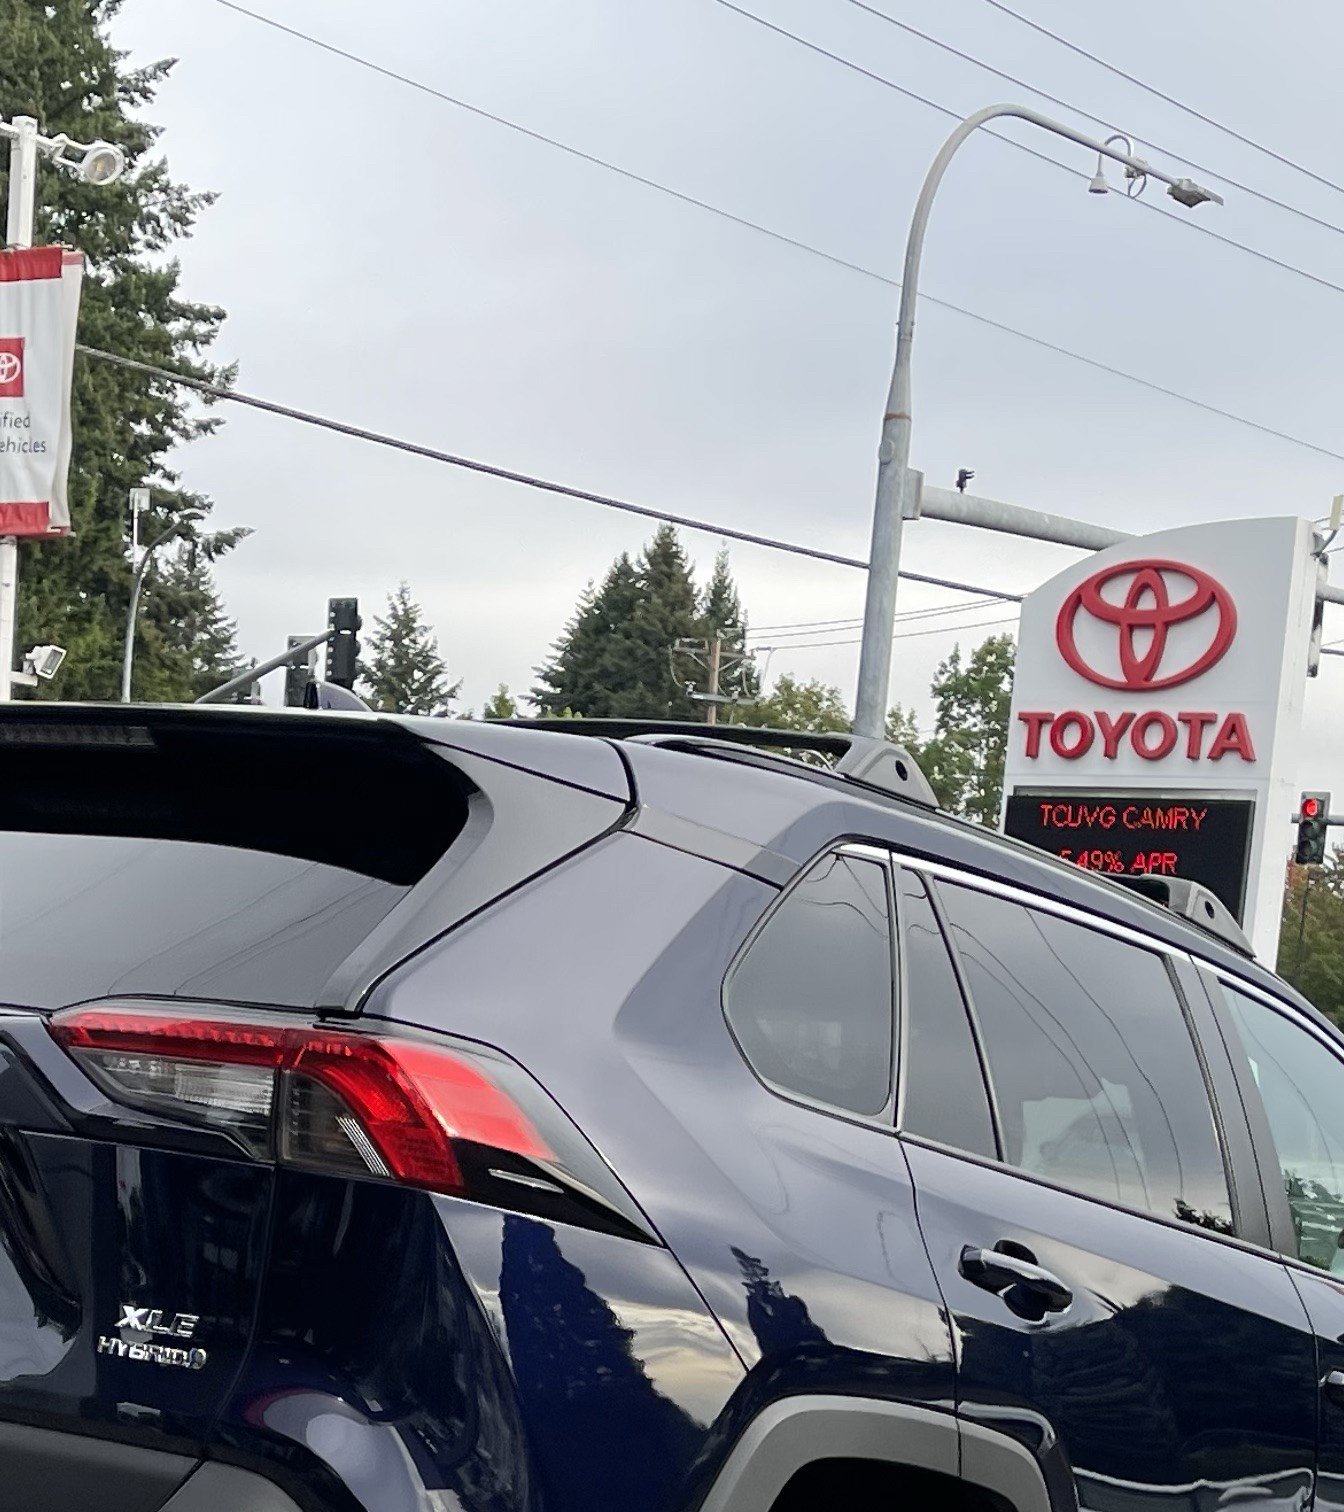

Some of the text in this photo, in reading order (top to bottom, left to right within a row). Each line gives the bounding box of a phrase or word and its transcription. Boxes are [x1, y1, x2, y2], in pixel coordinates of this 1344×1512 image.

[1018, 710, 1257, 763] TOYOTA
[1122, 805, 1208, 831] CAMRY
[1130, 851, 1178, 875] APR
[96, 1335, 208, 1370] HYBRID
